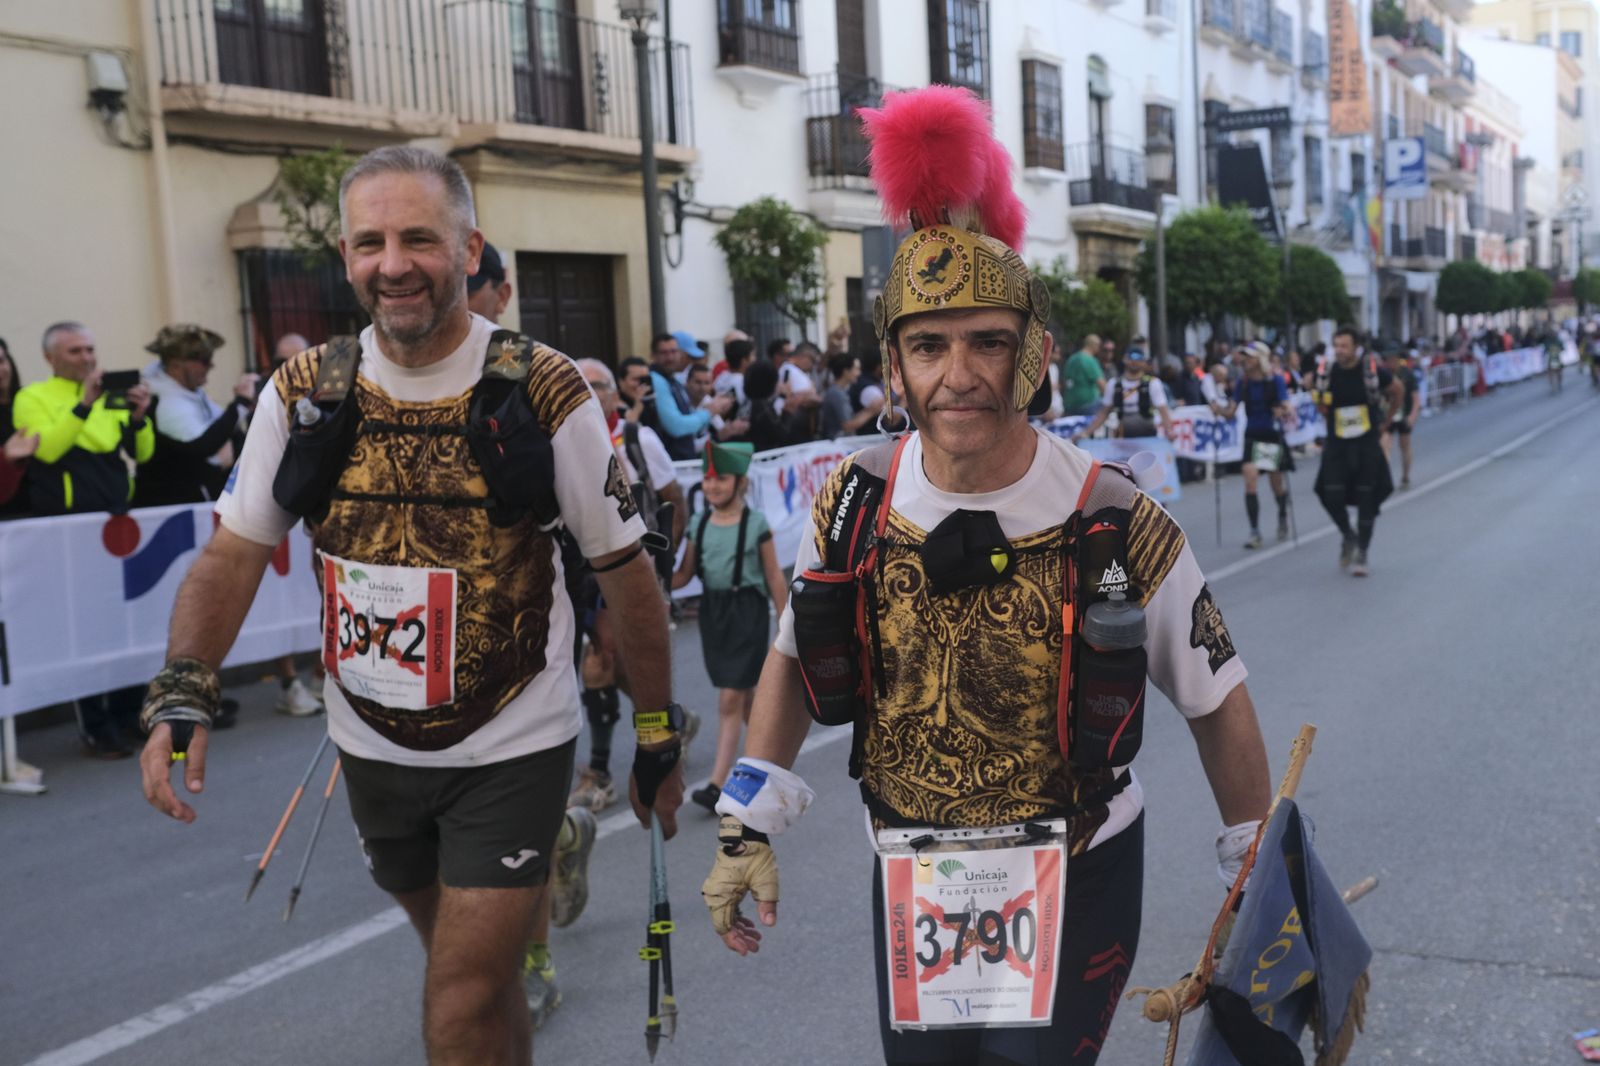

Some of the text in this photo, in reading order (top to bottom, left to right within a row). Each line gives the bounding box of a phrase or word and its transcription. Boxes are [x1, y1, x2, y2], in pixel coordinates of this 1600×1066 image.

[1347, 49, 1360, 101] HOTEL
[1385, 138, 1421, 182] P
[830, 474, 859, 542] AONIJIE
[368, 581, 404, 594] Unicaja
[339, 606, 426, 663] 3972
[939, 885, 1008, 896] Fundación
[965, 867, 1008, 882] Unicaja
[915, 907, 1037, 968] 3790
[1041, 923, 1052, 973] EDICIÓN
